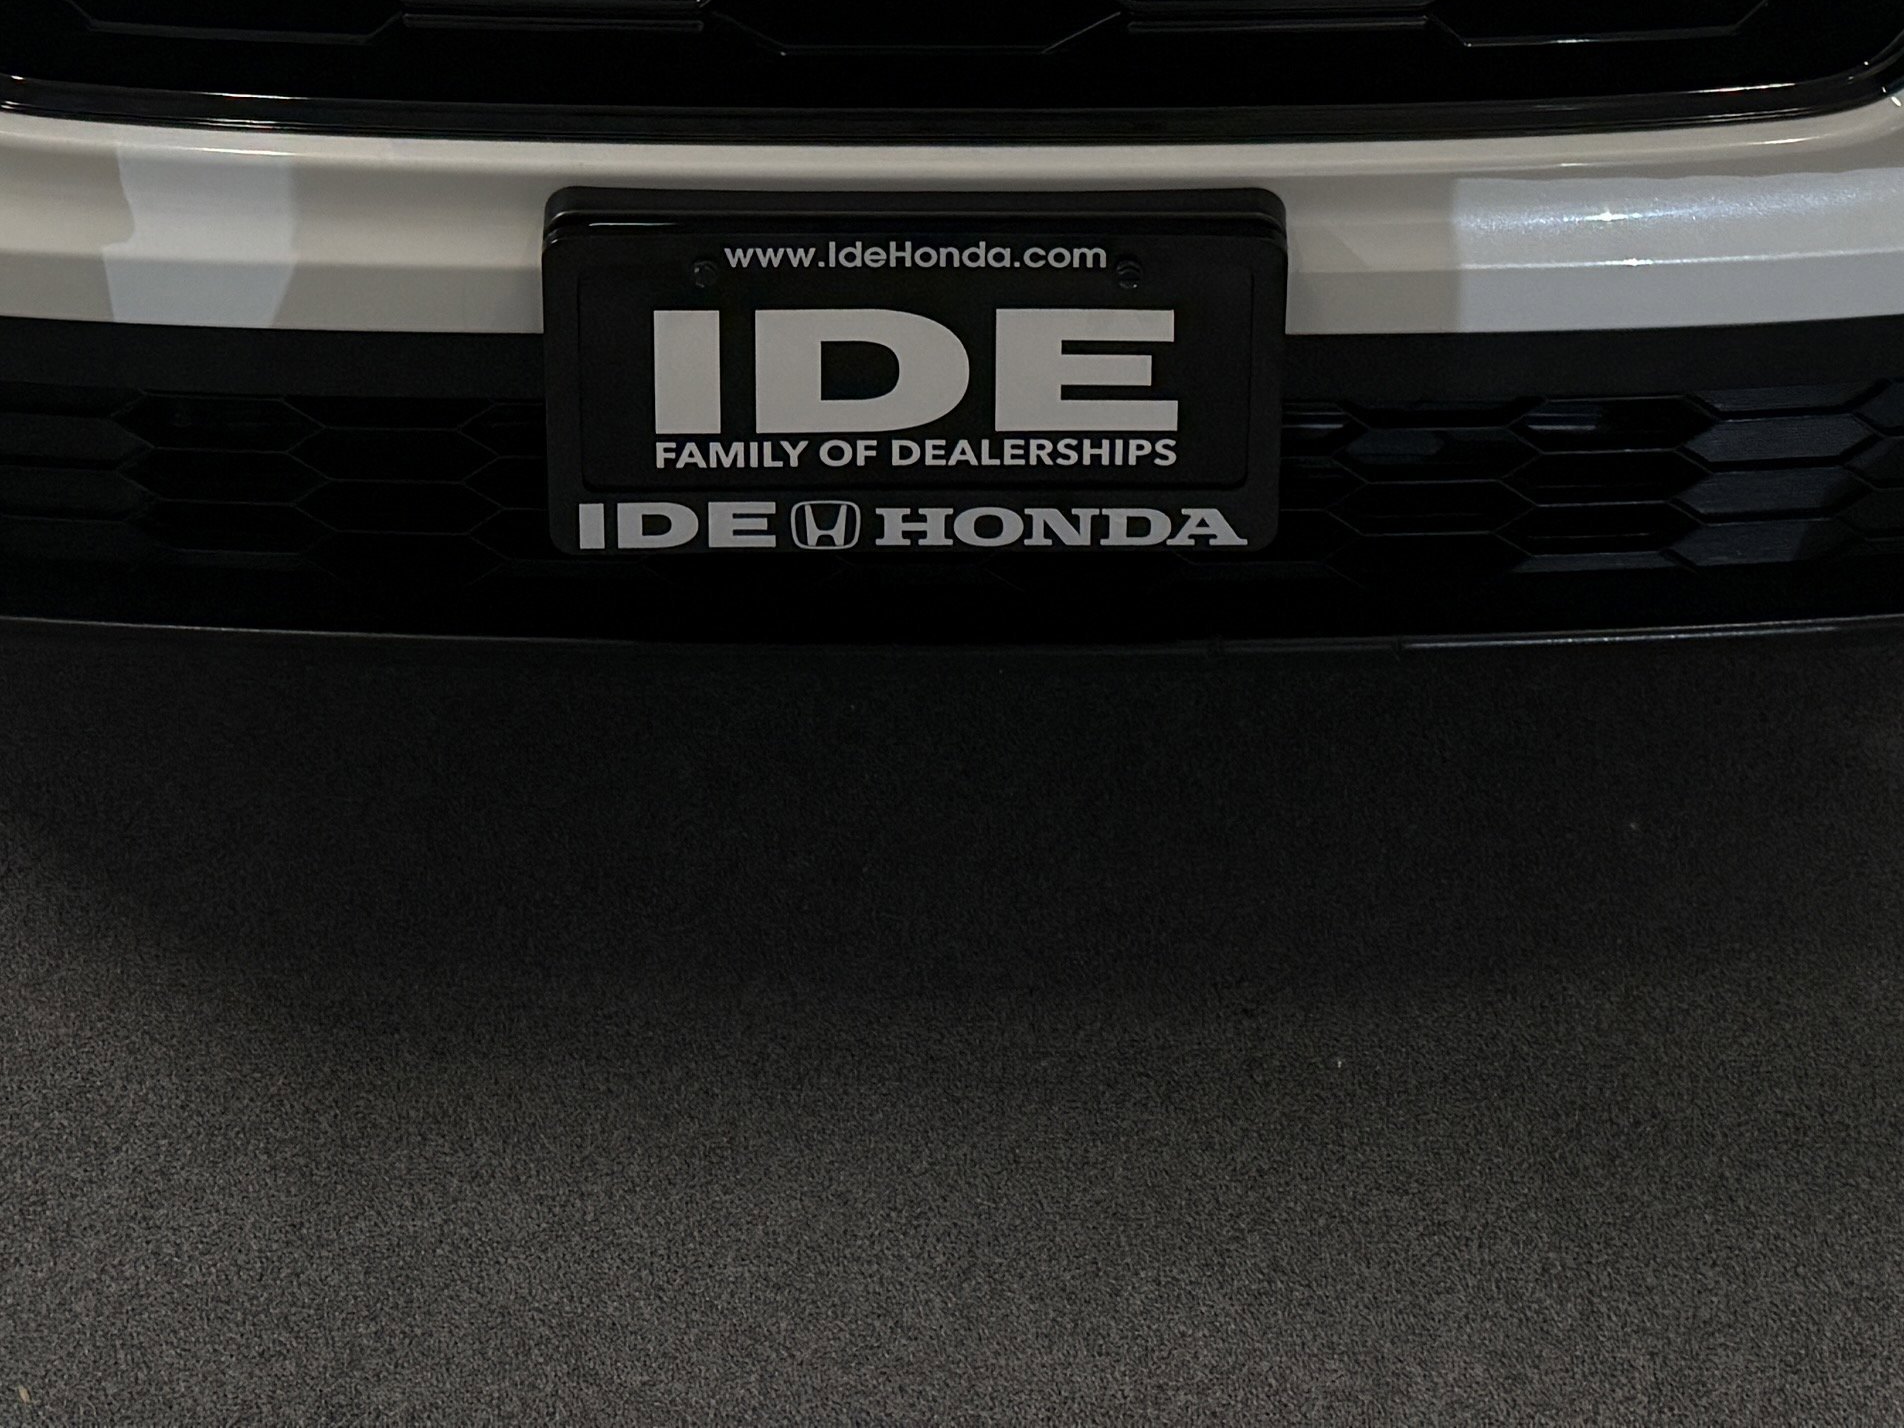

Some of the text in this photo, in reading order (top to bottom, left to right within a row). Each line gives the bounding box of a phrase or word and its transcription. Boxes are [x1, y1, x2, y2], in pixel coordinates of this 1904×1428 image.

[723, 241, 1107, 268] www.IdeHonda.com
[653, 308, 1179, 435] IDE
[655, 438, 1177, 469] FAMILY OF DEALERSHIPS
[578, 501, 777, 550] IDE
[875, 507, 1248, 547] HONDA
